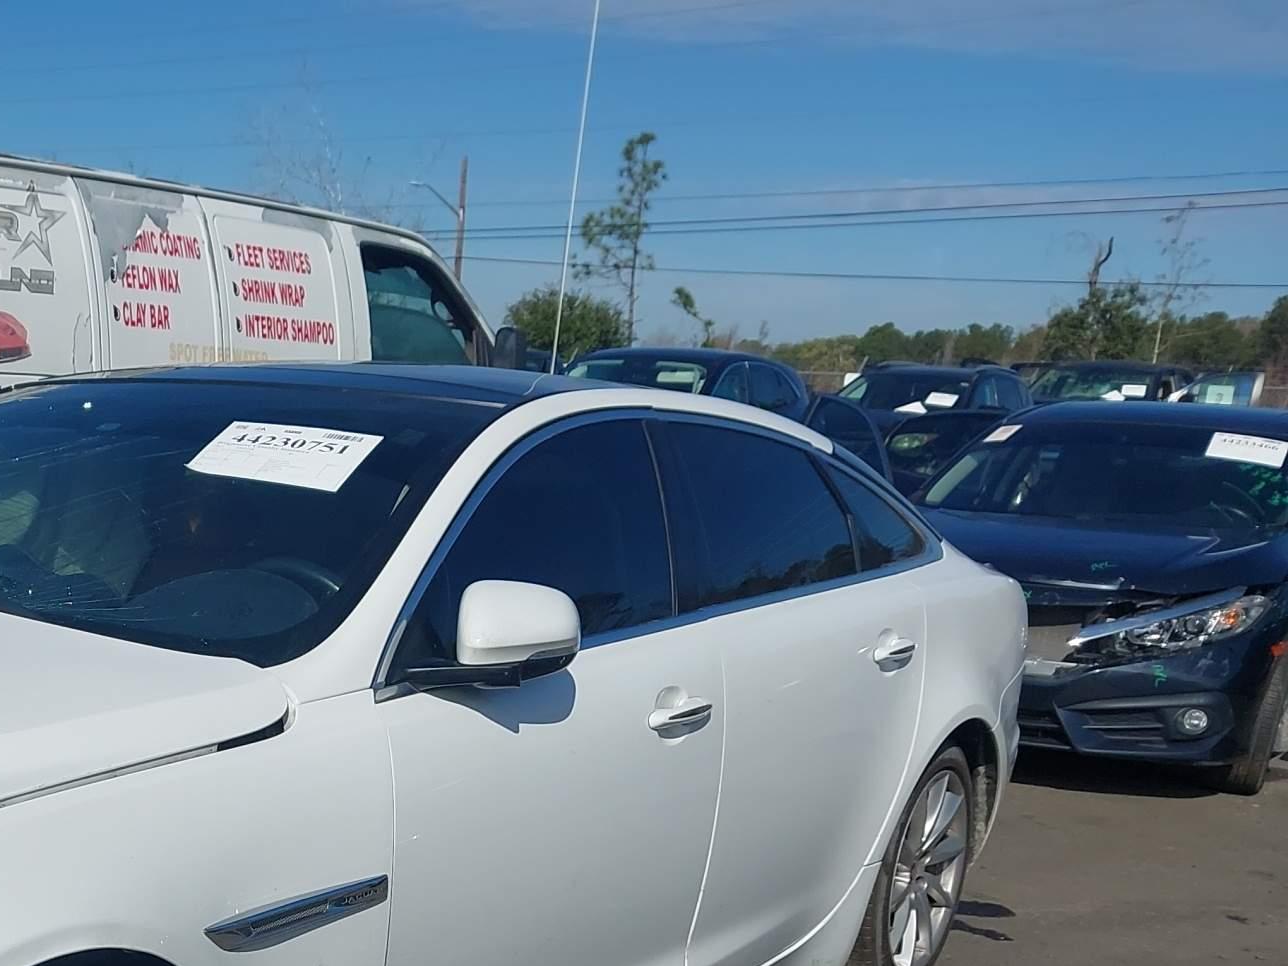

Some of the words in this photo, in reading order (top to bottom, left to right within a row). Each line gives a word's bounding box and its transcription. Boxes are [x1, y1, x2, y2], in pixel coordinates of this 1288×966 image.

[159, 231, 201, 260] COATING
[235, 243, 265, 269] FLEET
[267, 247, 312, 275] SERVICES
[158, 266, 181, 294] WAX
[241, 278, 278, 305] SHRINK
[279, 282, 306, 308] WRAP
[122, 301, 147, 328] CLAY
[150, 303, 171, 330] BAR
[245, 313, 290, 341] INTERIOR
[291, 318, 335, 346] SHAMPOO
[169, 342, 199, 362] SPOT
[231, 433, 350, 455] 44230751
